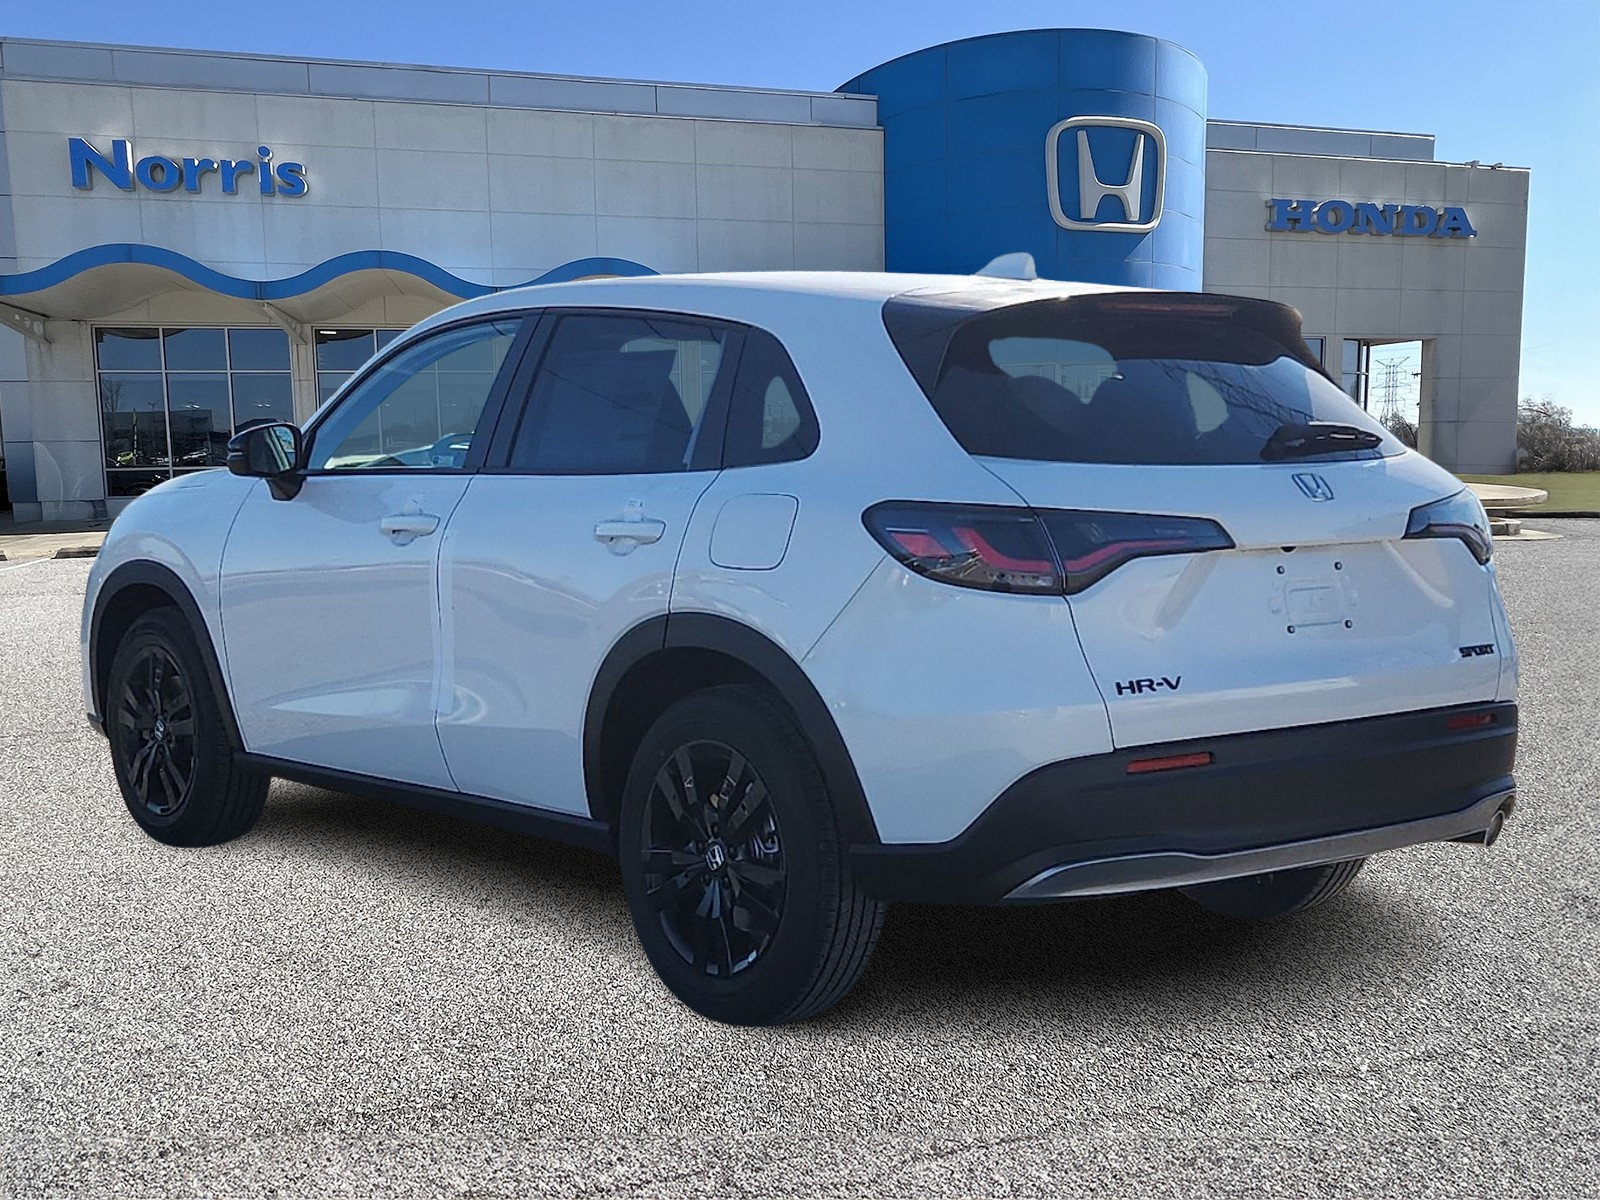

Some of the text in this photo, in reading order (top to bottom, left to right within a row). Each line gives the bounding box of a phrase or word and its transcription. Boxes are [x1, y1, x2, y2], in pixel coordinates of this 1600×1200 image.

[68, 137, 309, 197] Norris
[1265, 198, 1478, 239] HONDA
[1459, 643, 1494, 658] SPORT
[1115, 675, 1181, 695] HR-V
